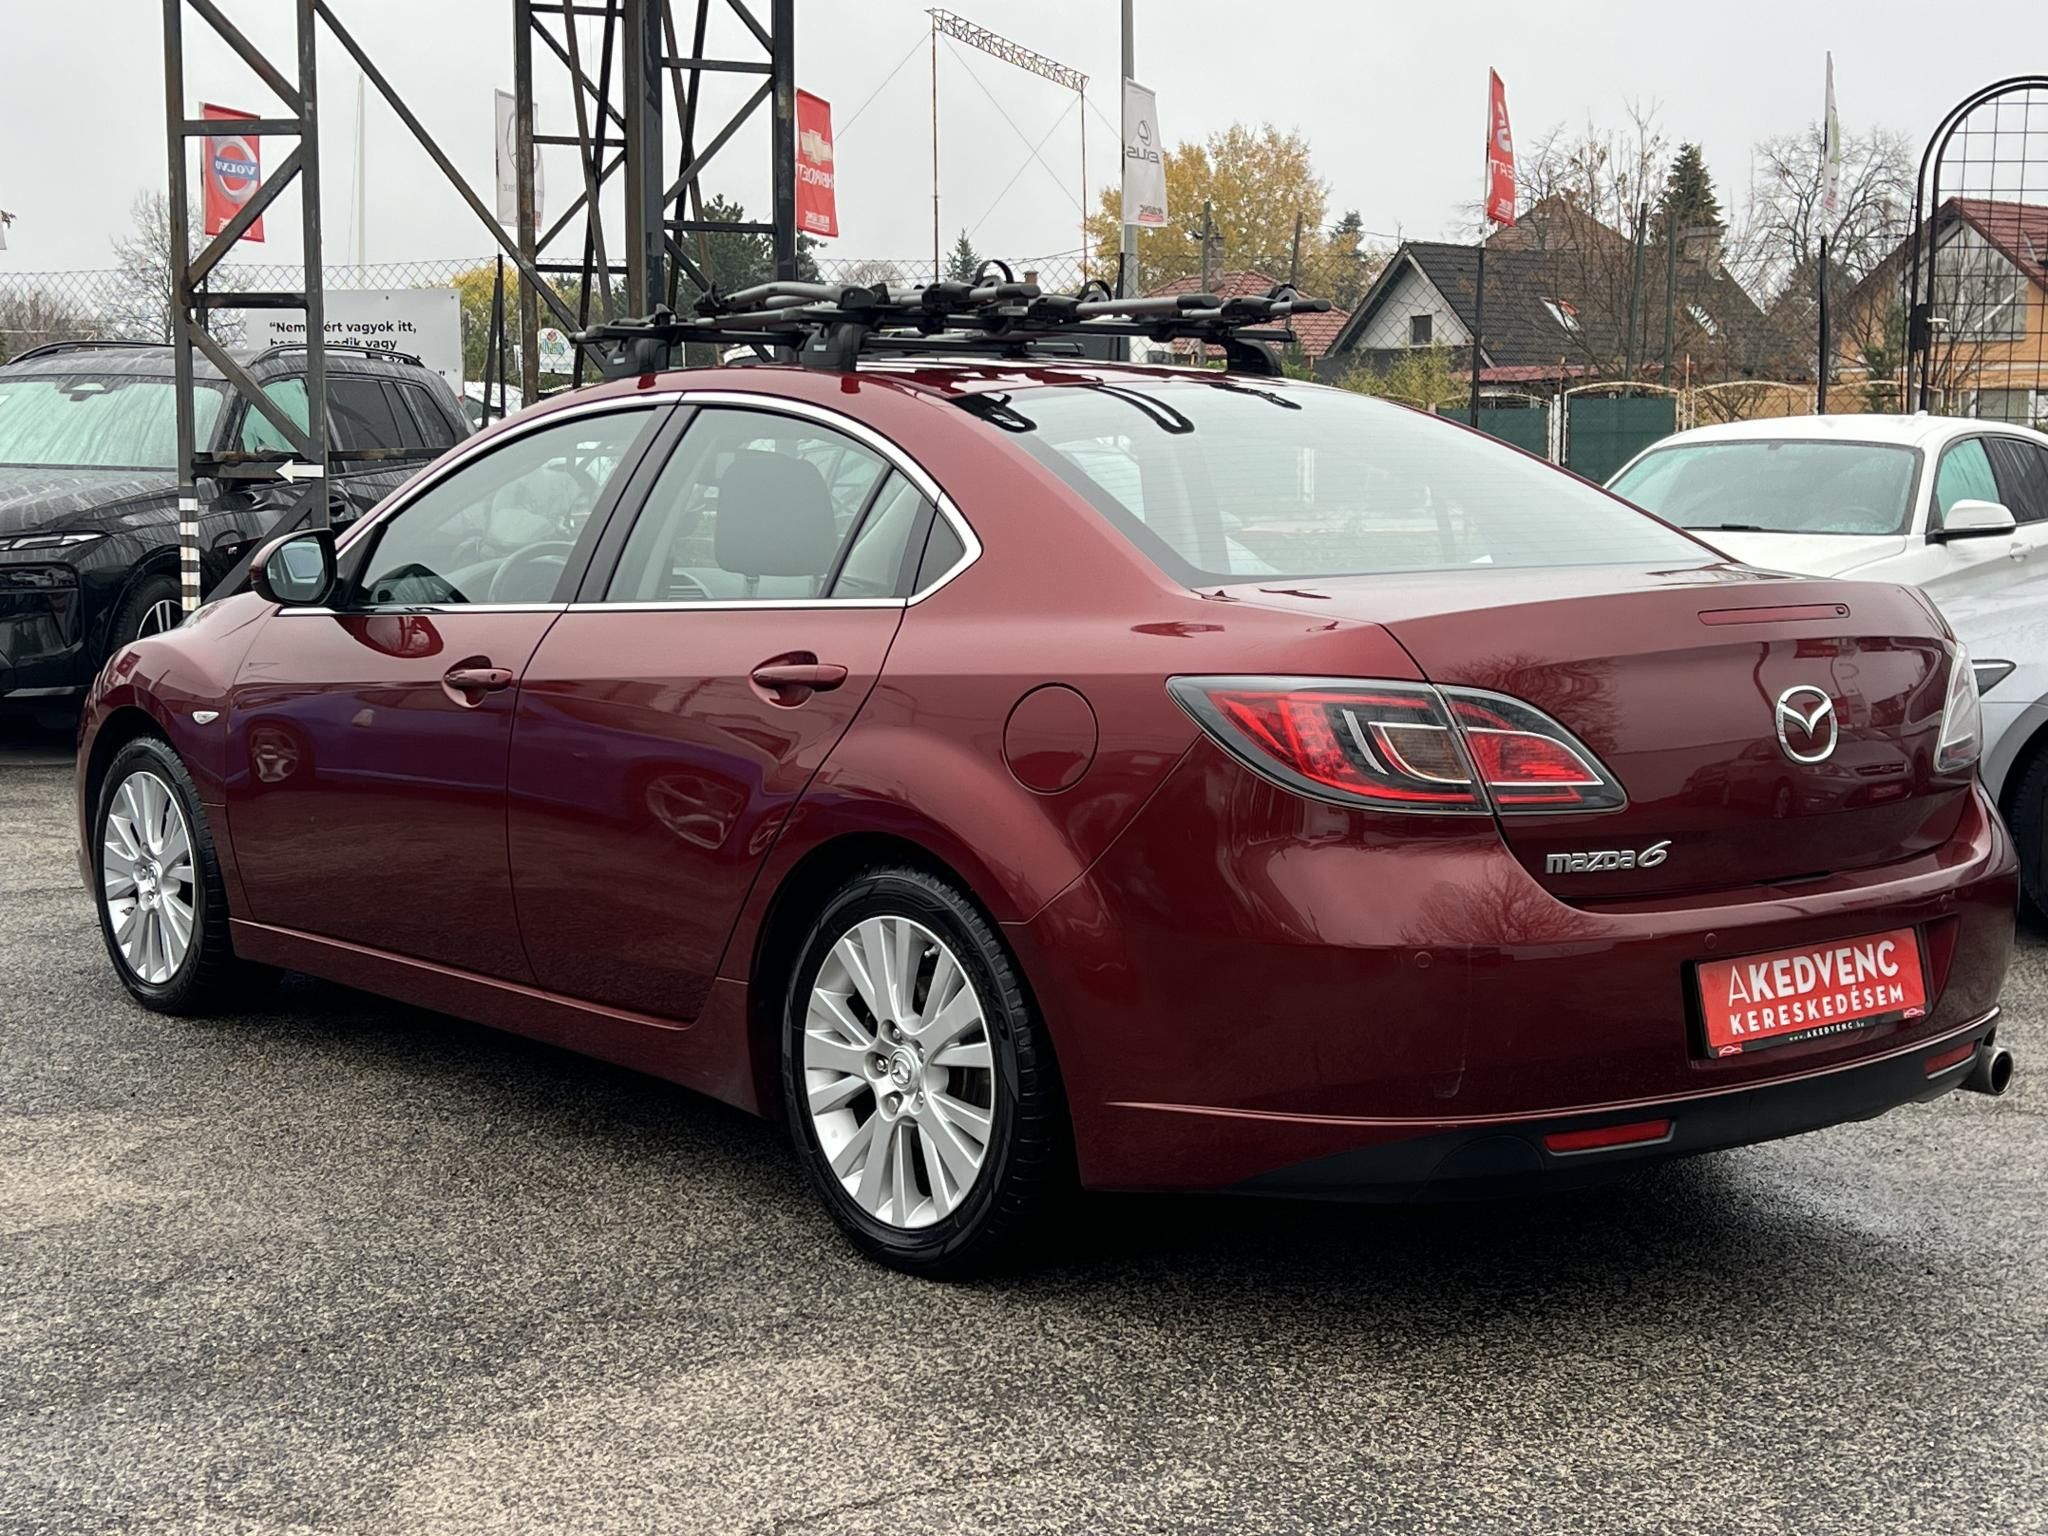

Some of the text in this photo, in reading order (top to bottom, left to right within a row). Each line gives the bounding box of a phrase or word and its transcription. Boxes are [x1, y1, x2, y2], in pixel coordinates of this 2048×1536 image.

[346, 320, 394, 334] vagyok
[398, 320, 417, 334] itt,
[1728, 940, 1899, 1007] AKEDVENC
[1729, 982, 1904, 1036] KERESKEDÉSEM
